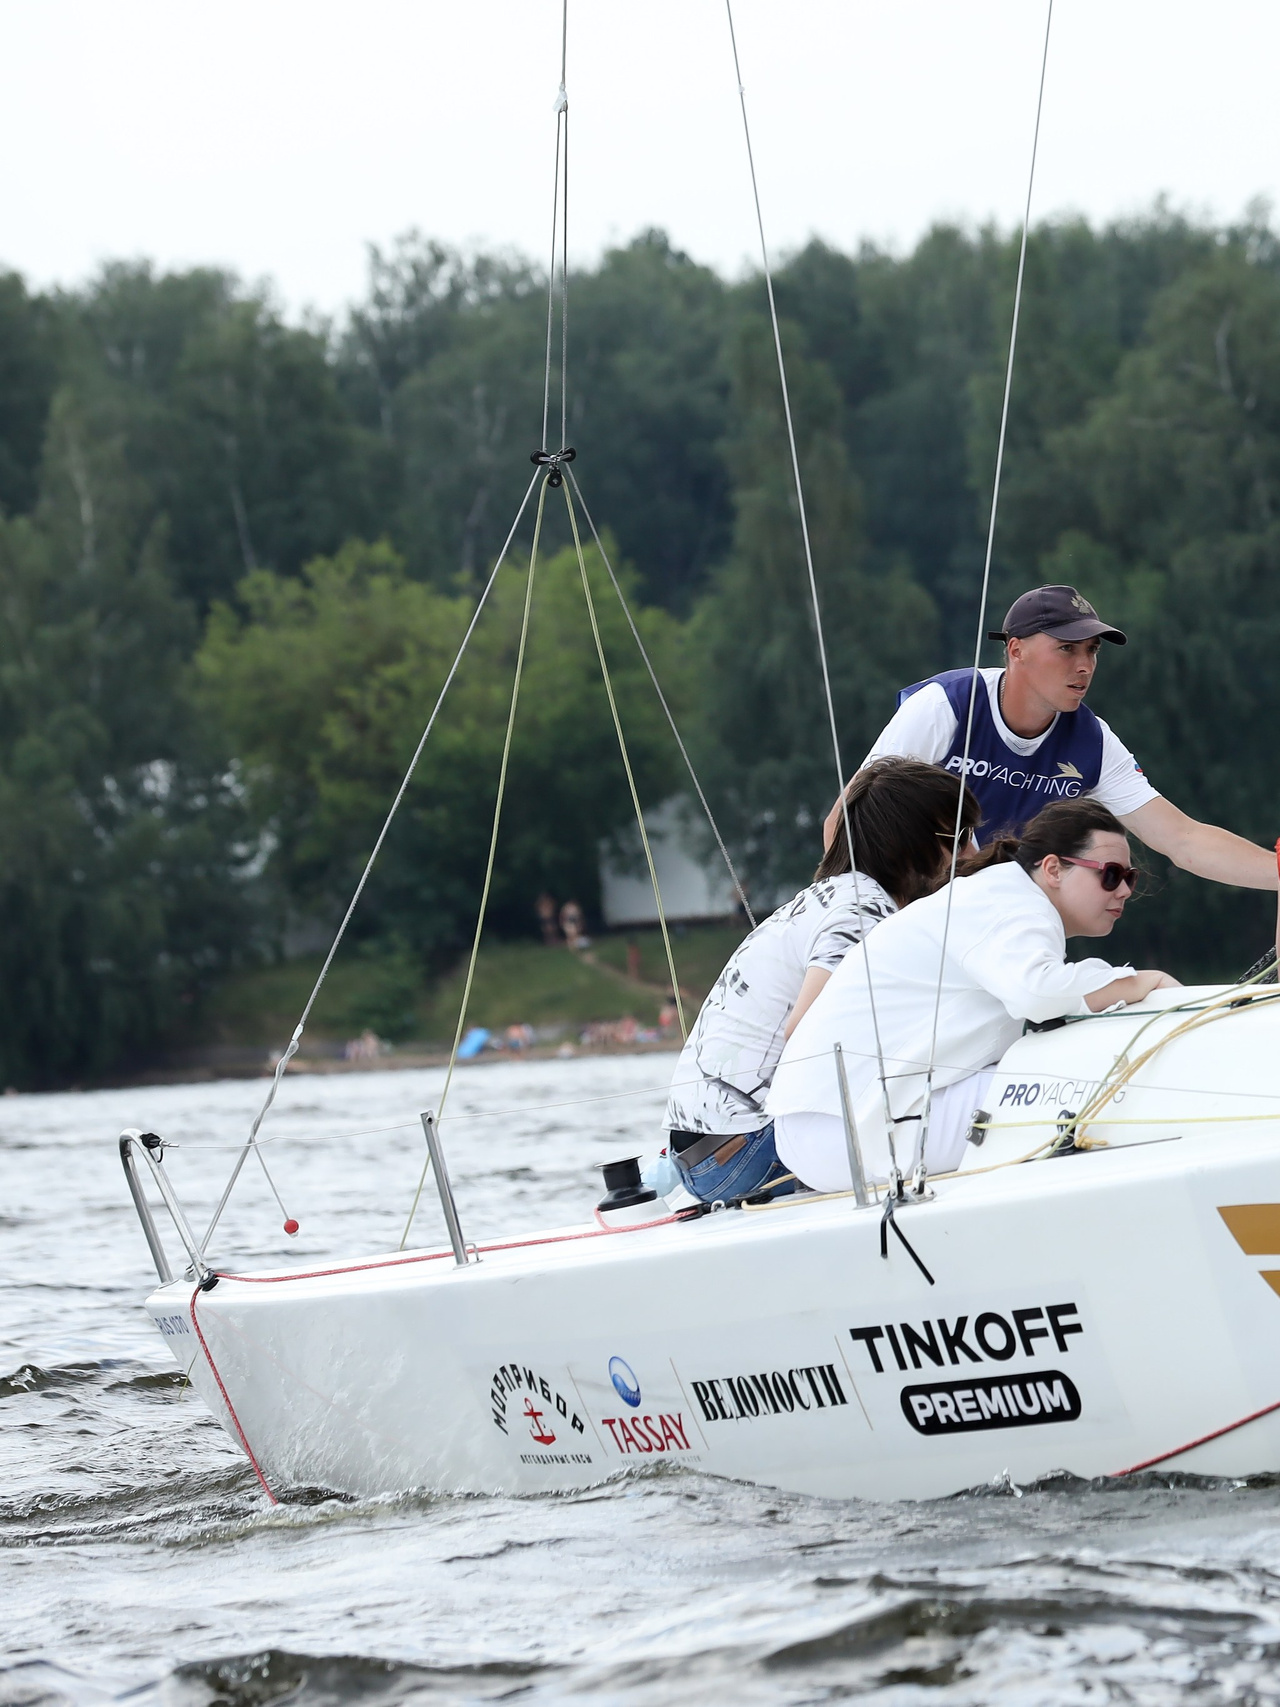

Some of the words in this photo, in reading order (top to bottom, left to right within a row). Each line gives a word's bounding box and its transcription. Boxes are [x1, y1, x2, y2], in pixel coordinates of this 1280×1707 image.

[944, 755, 1082, 798] PROYACHTING
[849, 1302, 1084, 1374] TINKOFF
[690, 1363, 849, 1425] ВЕДОМОСТИ
[908, 1378, 1072, 1427] PREMIUM
[601, 1412, 692, 1455] TASSAY
